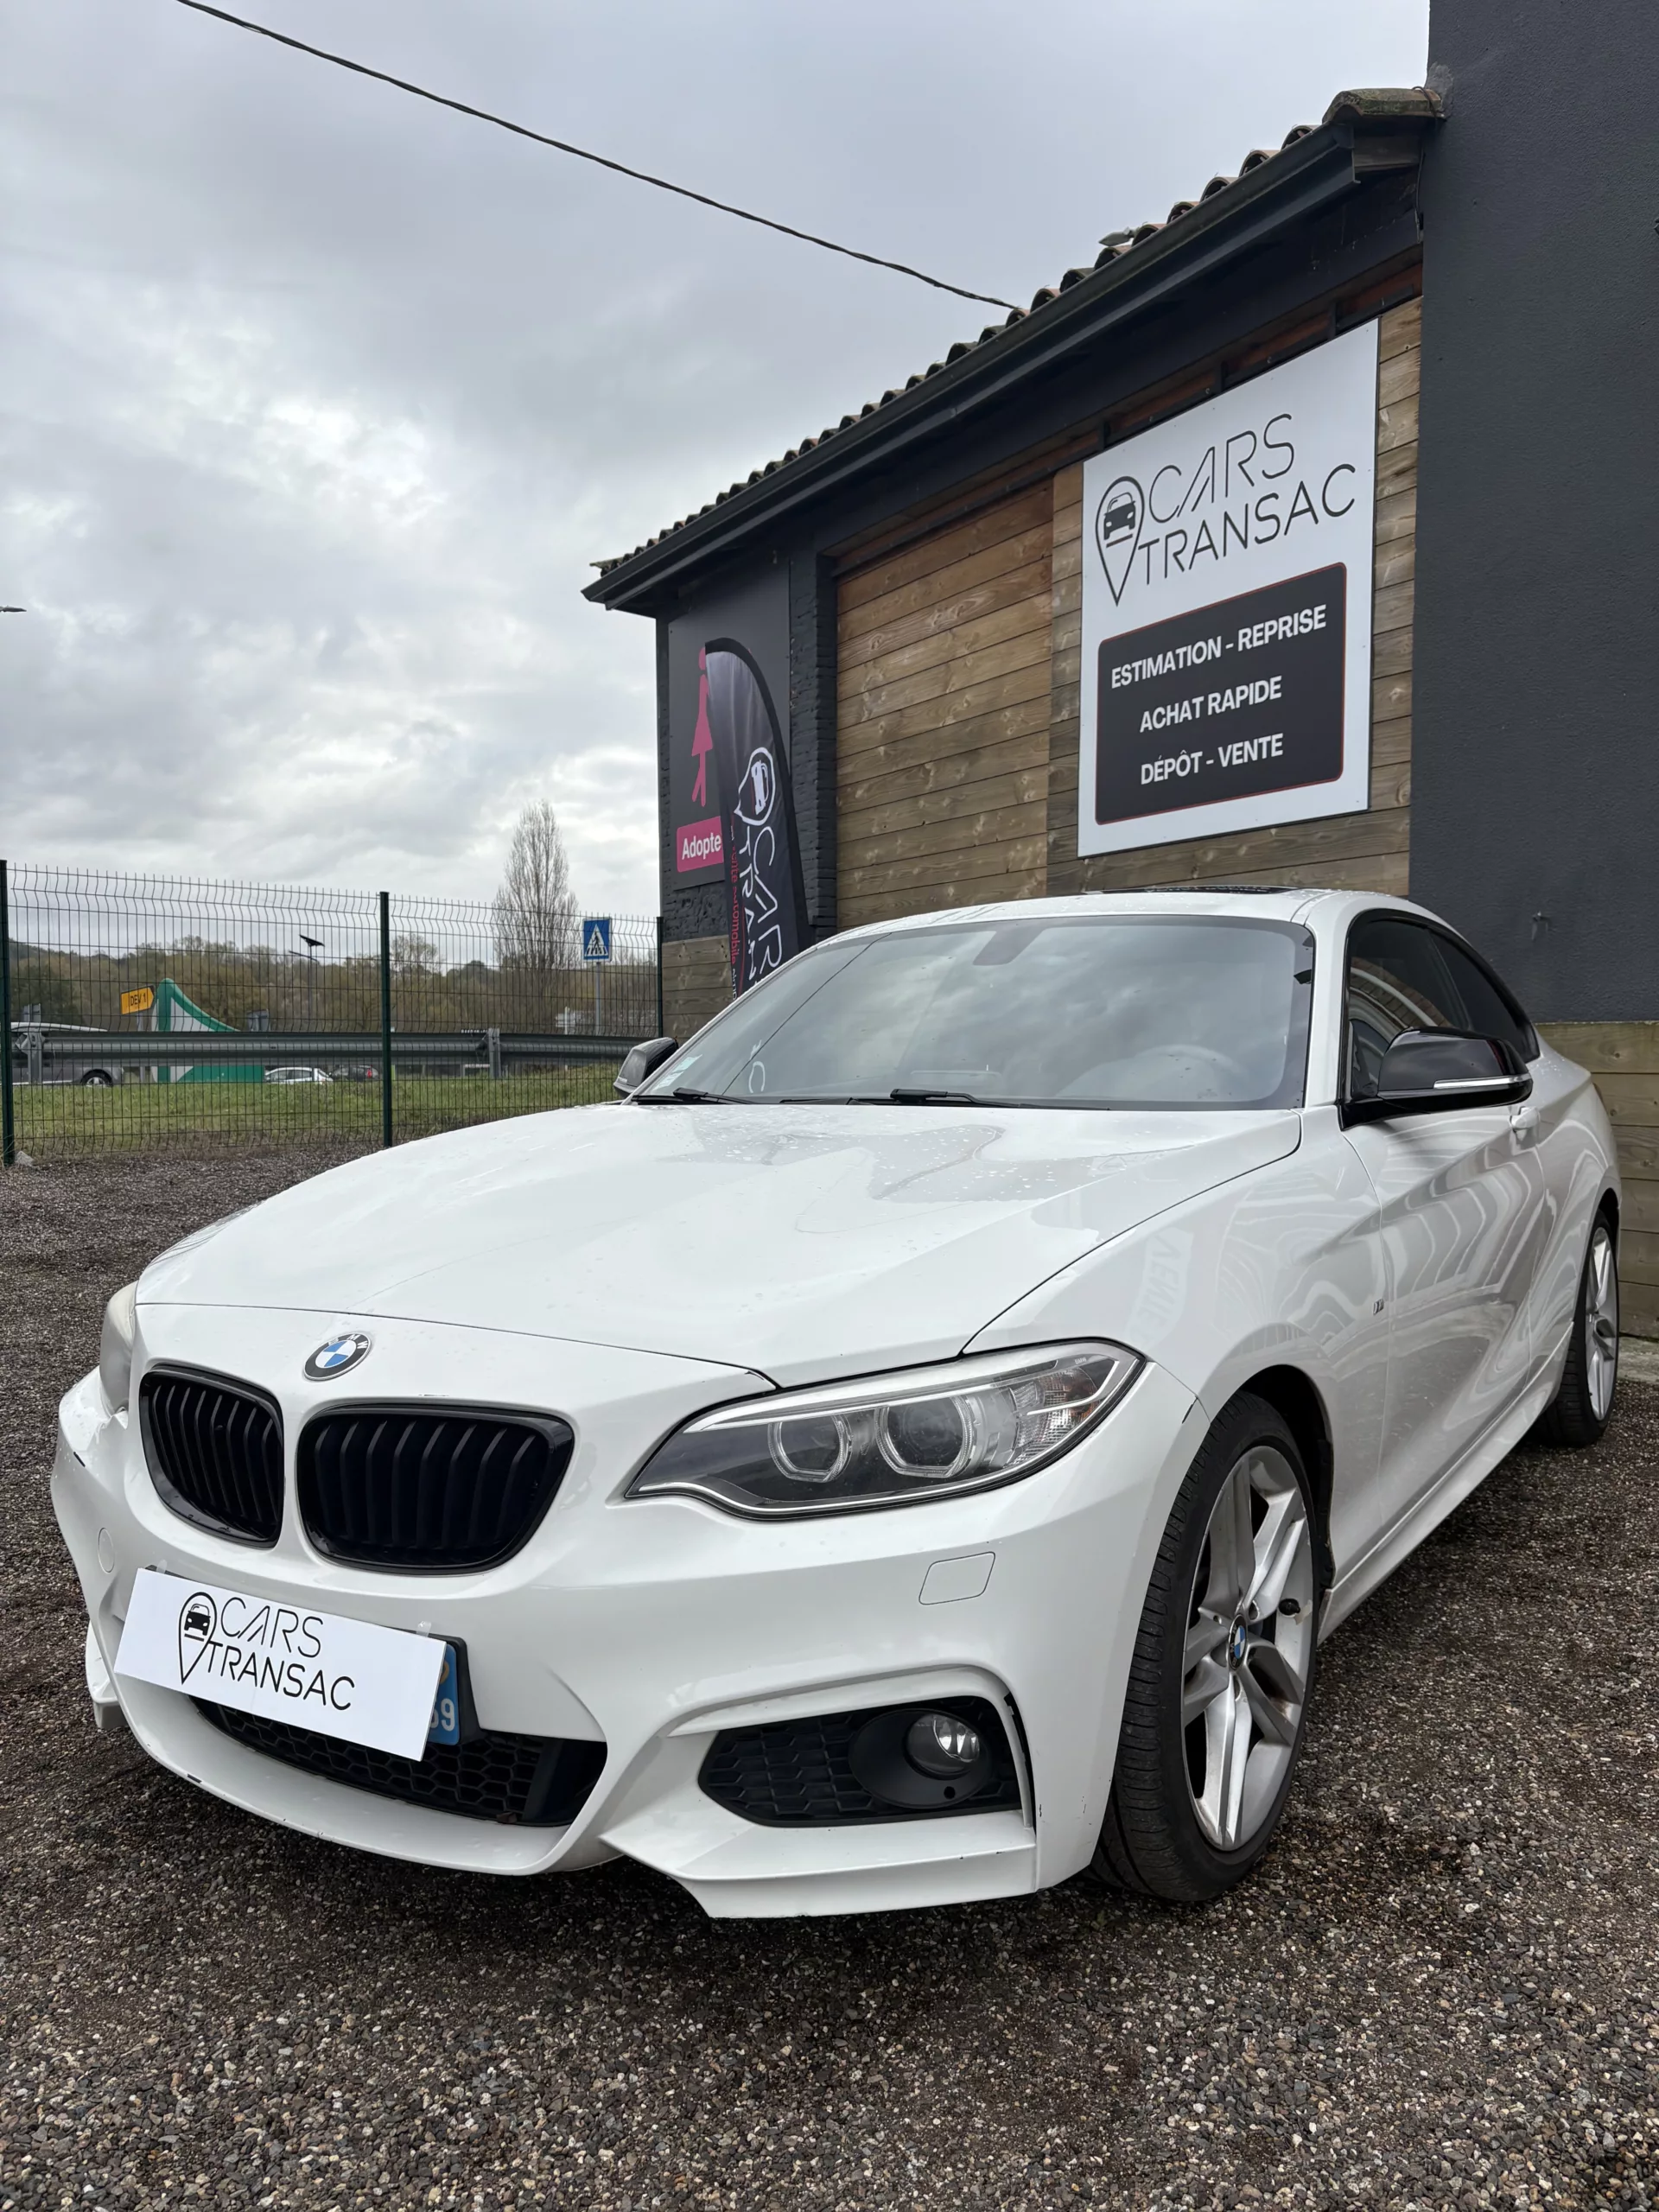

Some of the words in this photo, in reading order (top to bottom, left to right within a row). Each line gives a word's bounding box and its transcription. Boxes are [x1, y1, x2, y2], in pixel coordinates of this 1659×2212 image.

[1147, 413, 1294, 524] CARS
[1137, 463, 1356, 585] TRANSAC
[1111, 635, 1222, 689] ESTIMATION
[1237, 604, 1327, 652] REPRISE
[1140, 696, 1205, 734] ACHAT
[1207, 675, 1282, 716] RAPIDE
[1141, 748, 1203, 785] DÉPÔT
[1217, 733, 1284, 770] VENTE
[682, 832, 721, 860] Adopte
[220, 1596, 324, 1658] CARS
[207, 1640, 356, 1711] TRANSAC
